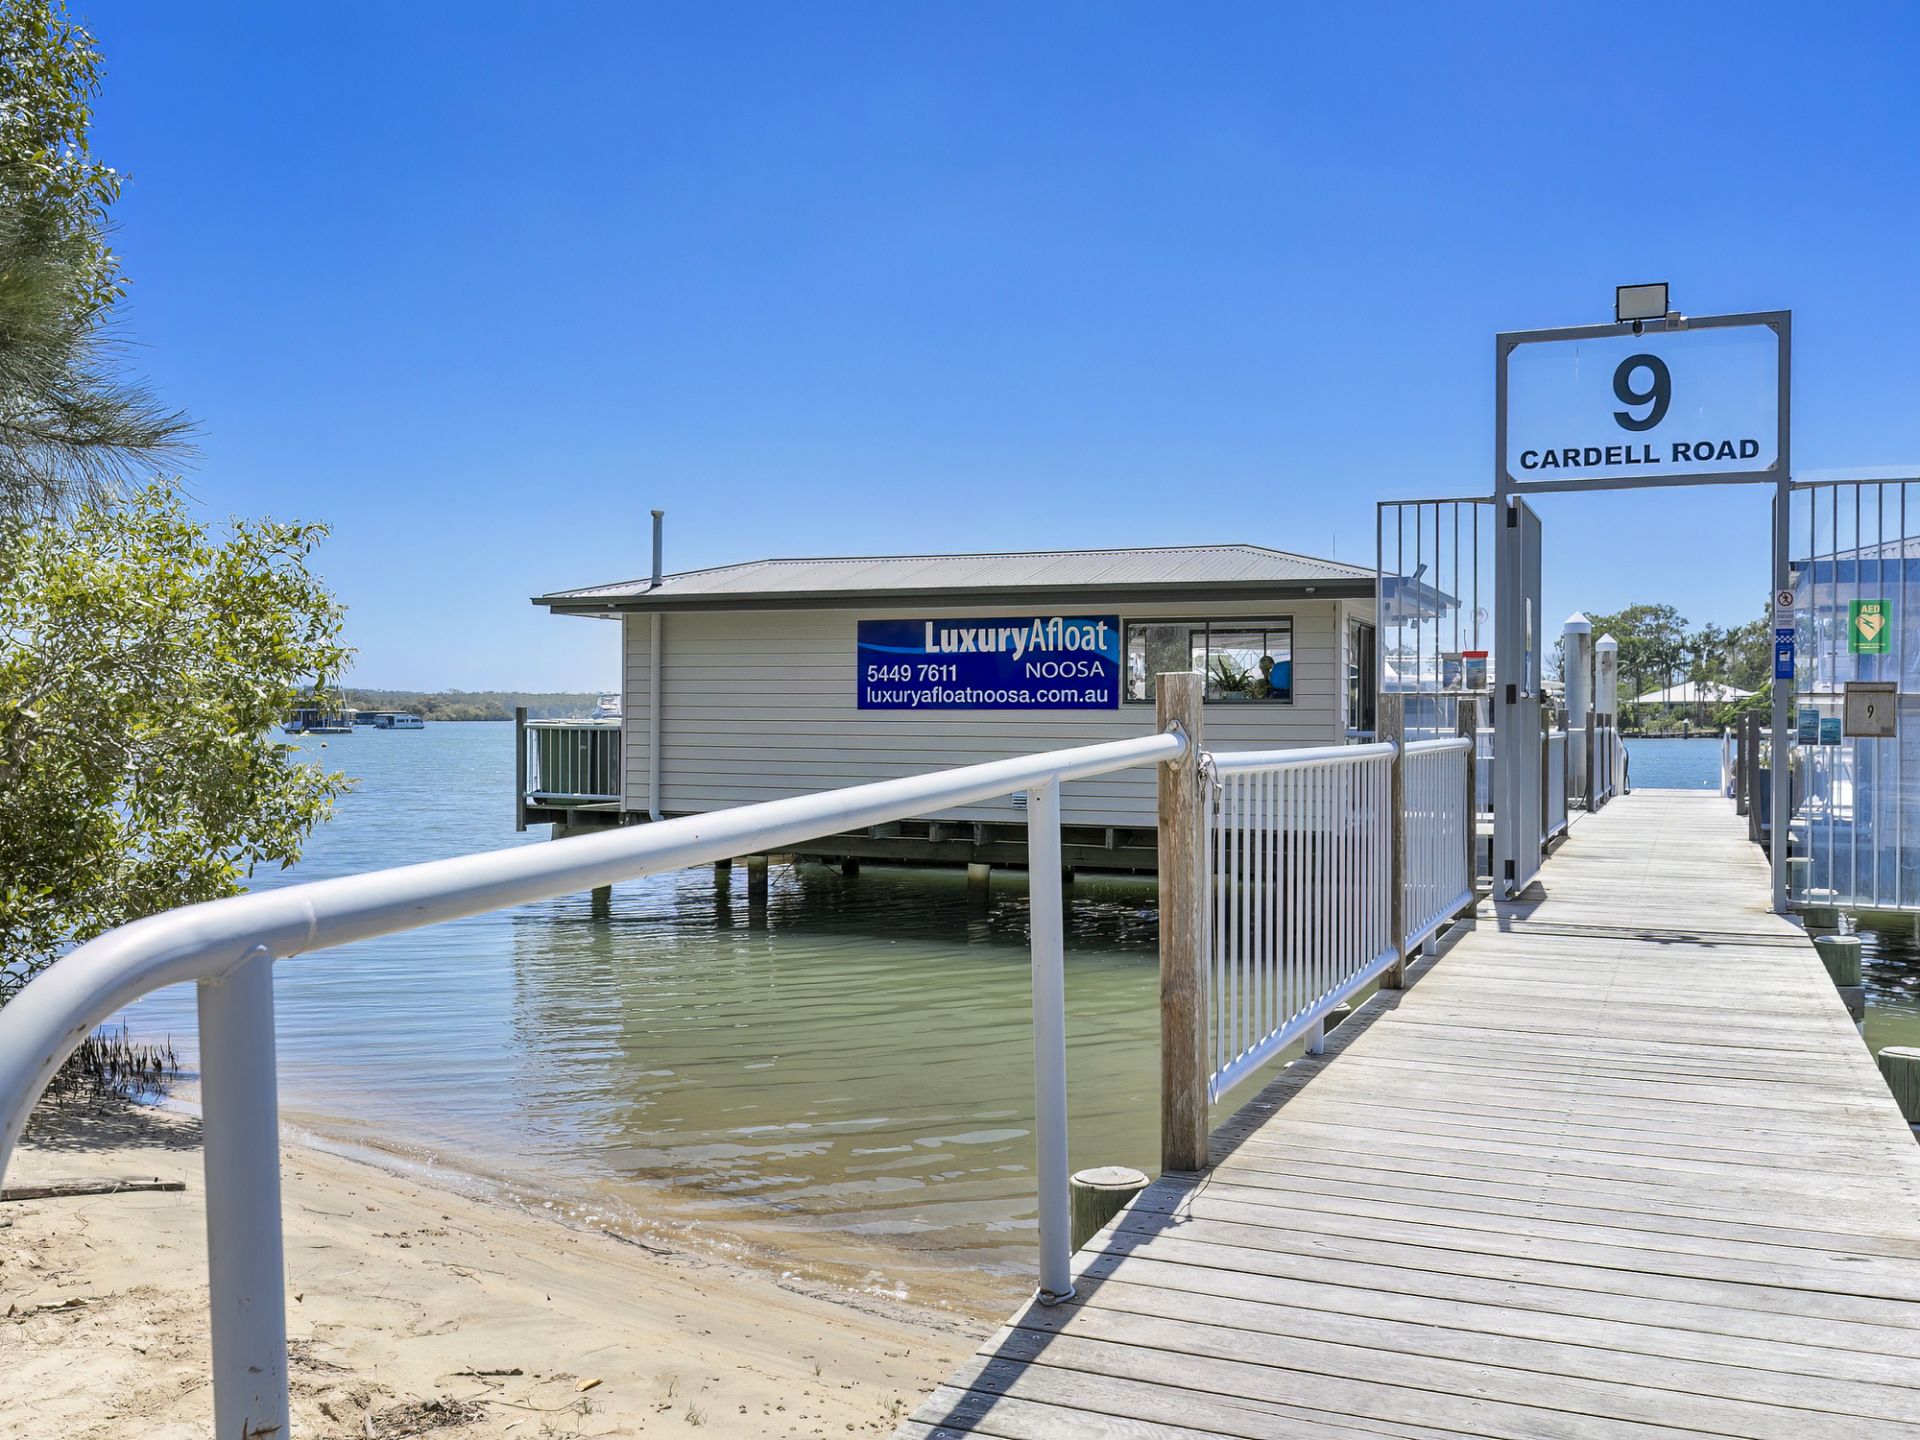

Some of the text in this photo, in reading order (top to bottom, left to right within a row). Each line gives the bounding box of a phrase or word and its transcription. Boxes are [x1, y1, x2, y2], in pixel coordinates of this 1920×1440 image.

[1612, 353, 1672, 432] 9
[1519, 439, 1760, 470] CARDELL ROAD
[1861, 604, 1880, 613] AED
[867, 664, 957, 682] 5449 7611
[1025, 661, 1105, 679] NOOSA
[867, 686, 1108, 707] luxuryafloatnoosa.com.au
[1867, 704, 1874, 719] 9
